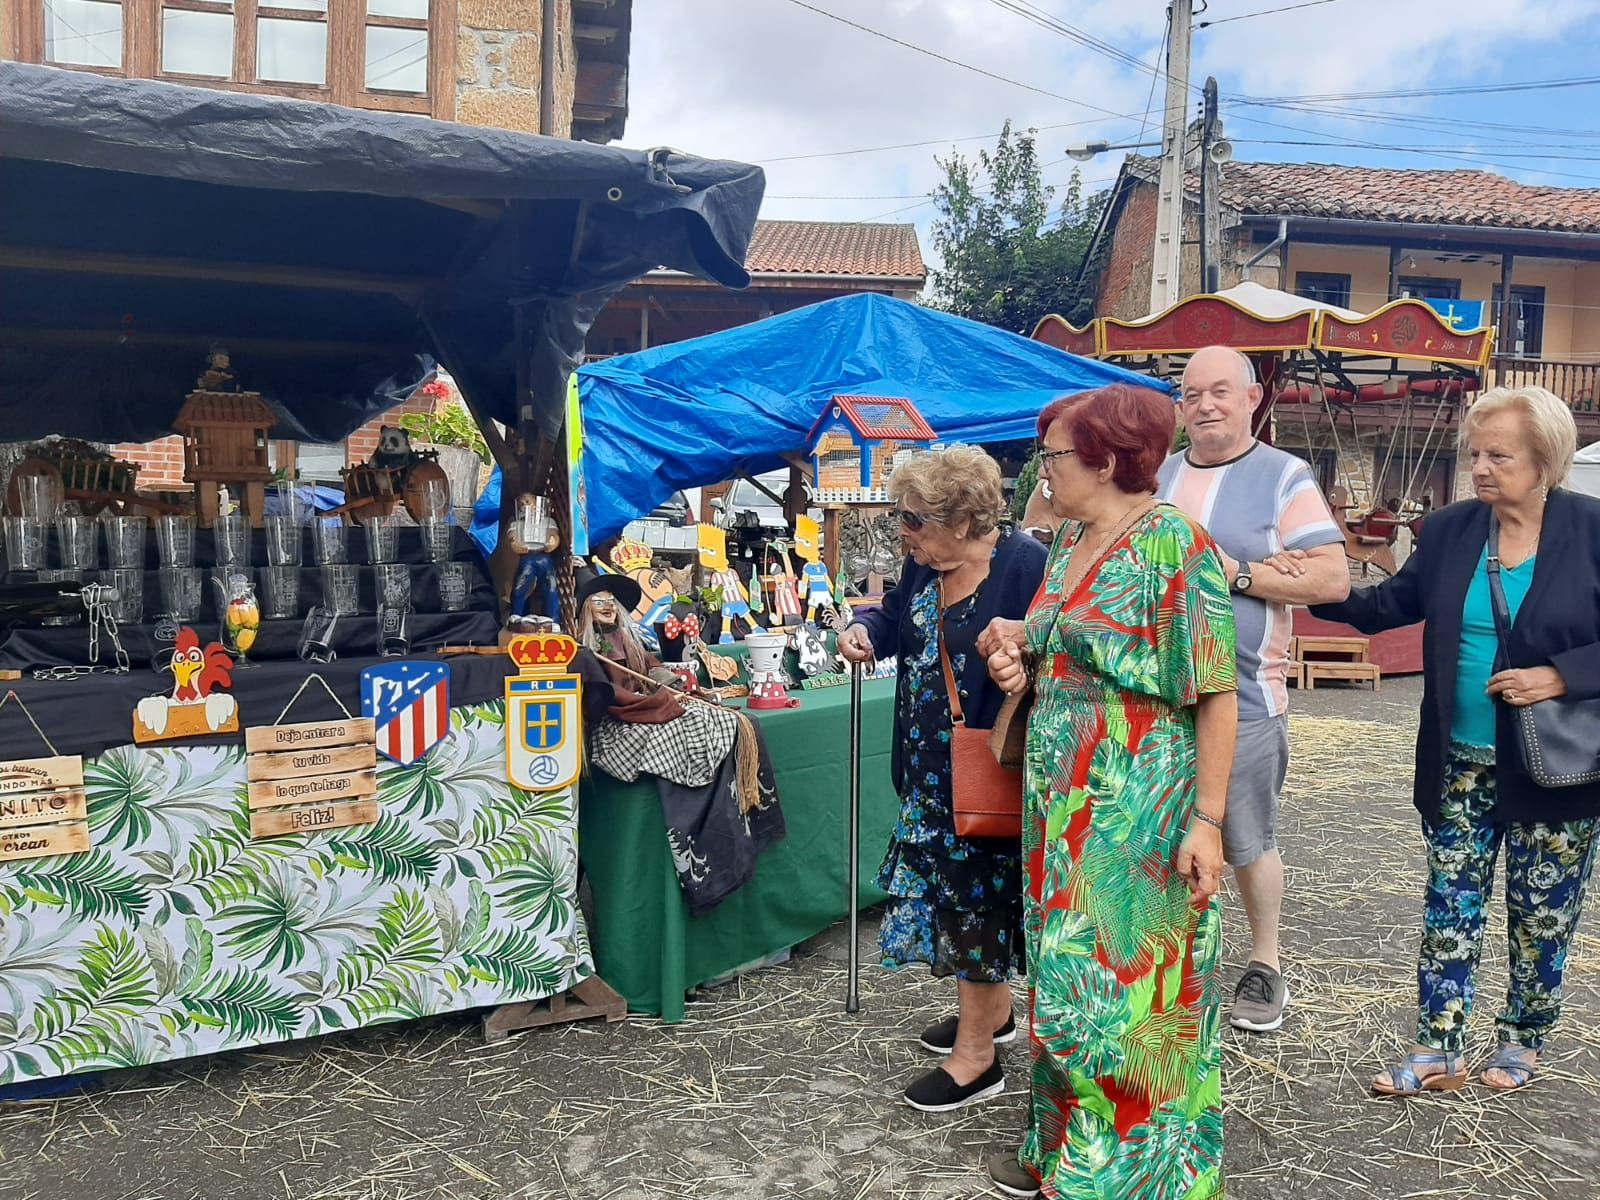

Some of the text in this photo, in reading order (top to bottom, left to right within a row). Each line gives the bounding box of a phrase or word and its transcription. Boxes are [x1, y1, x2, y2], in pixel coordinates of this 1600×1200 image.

[276, 727, 345, 742] Deja entrar a
[293, 754, 331, 768] tu vida
[12, 765, 49, 777] buscan
[276, 778, 350, 797] lo que te haga
[291, 807, 335, 828] Feliz!
[4, 839, 49, 852] crean
